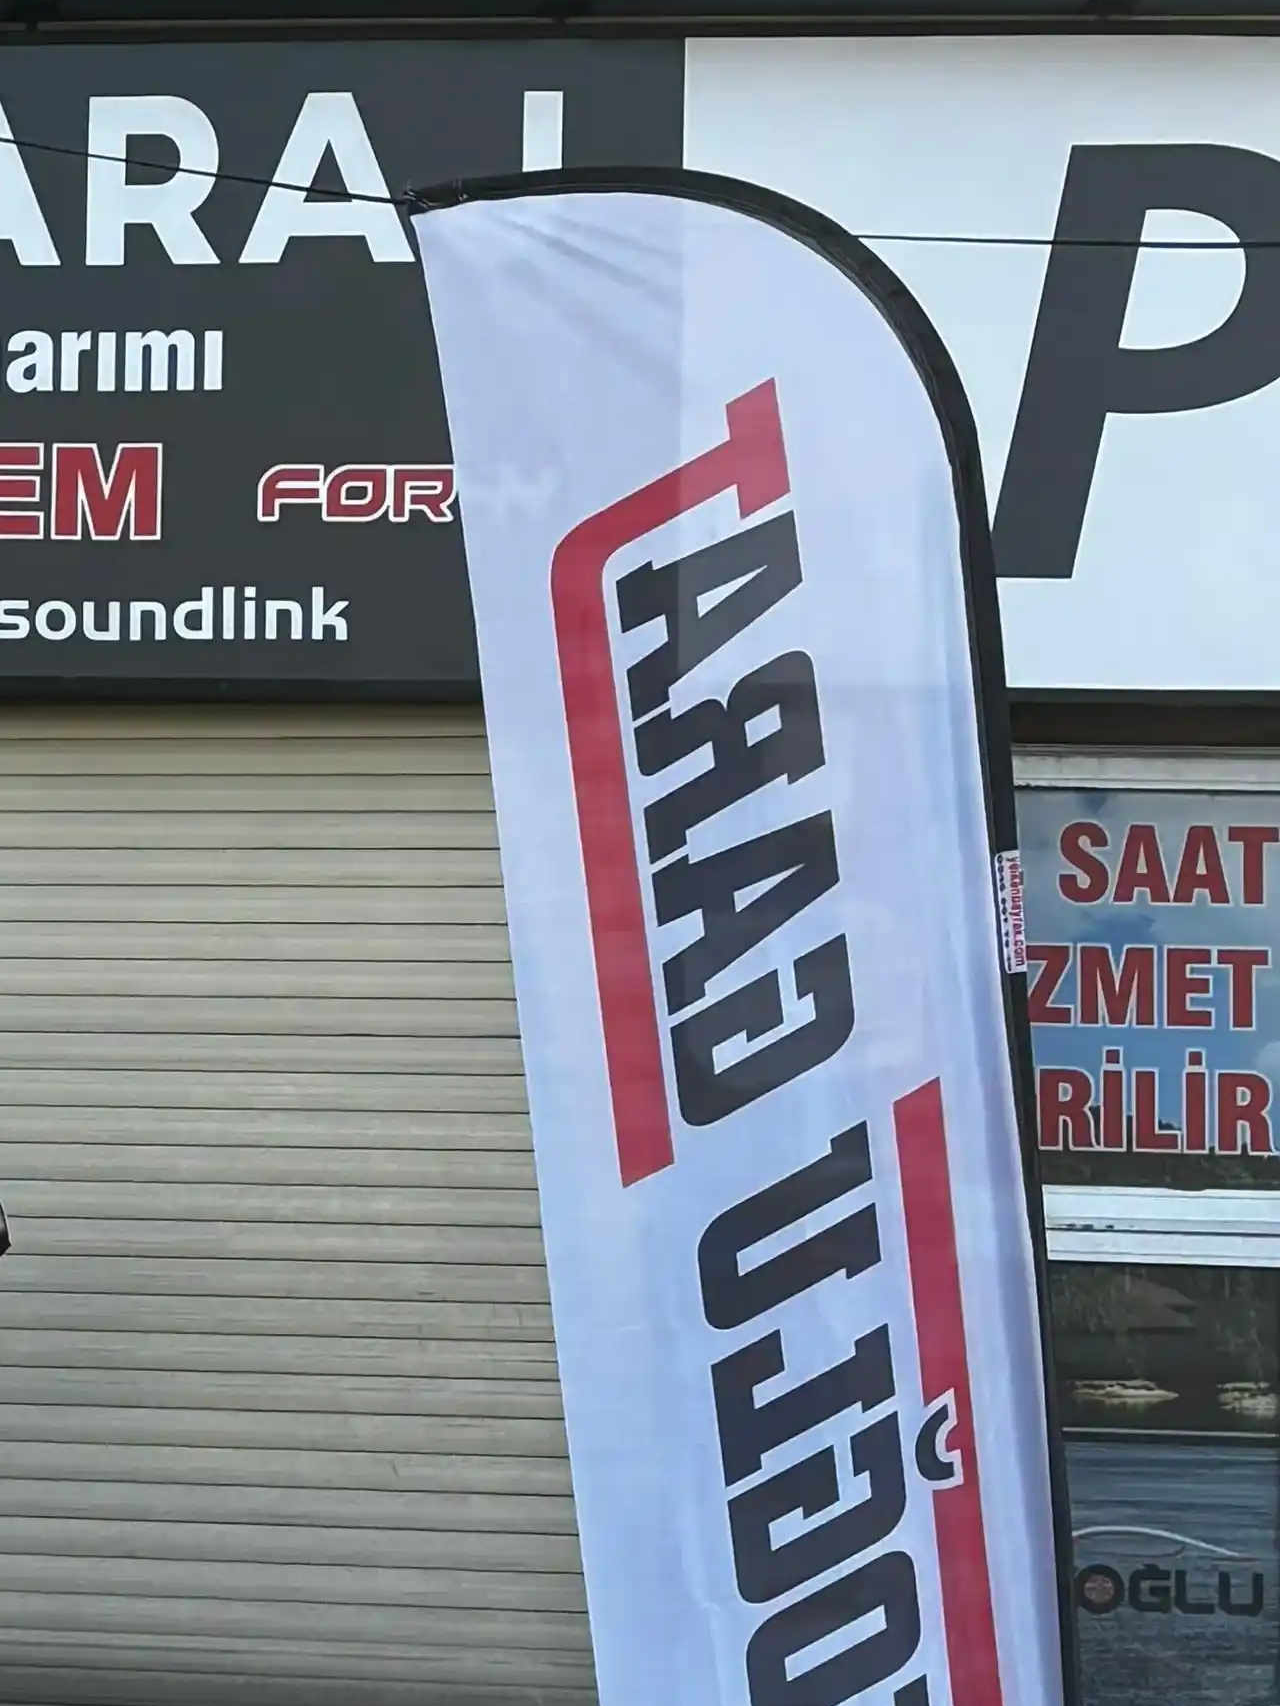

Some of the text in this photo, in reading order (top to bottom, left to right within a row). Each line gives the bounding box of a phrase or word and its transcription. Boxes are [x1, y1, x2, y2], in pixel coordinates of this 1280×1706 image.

[1056, 821, 1280, 906] SAAT
[1026, 943, 1271, 1031] ZMET
[1037, 1045, 1276, 1157] RİLİR
